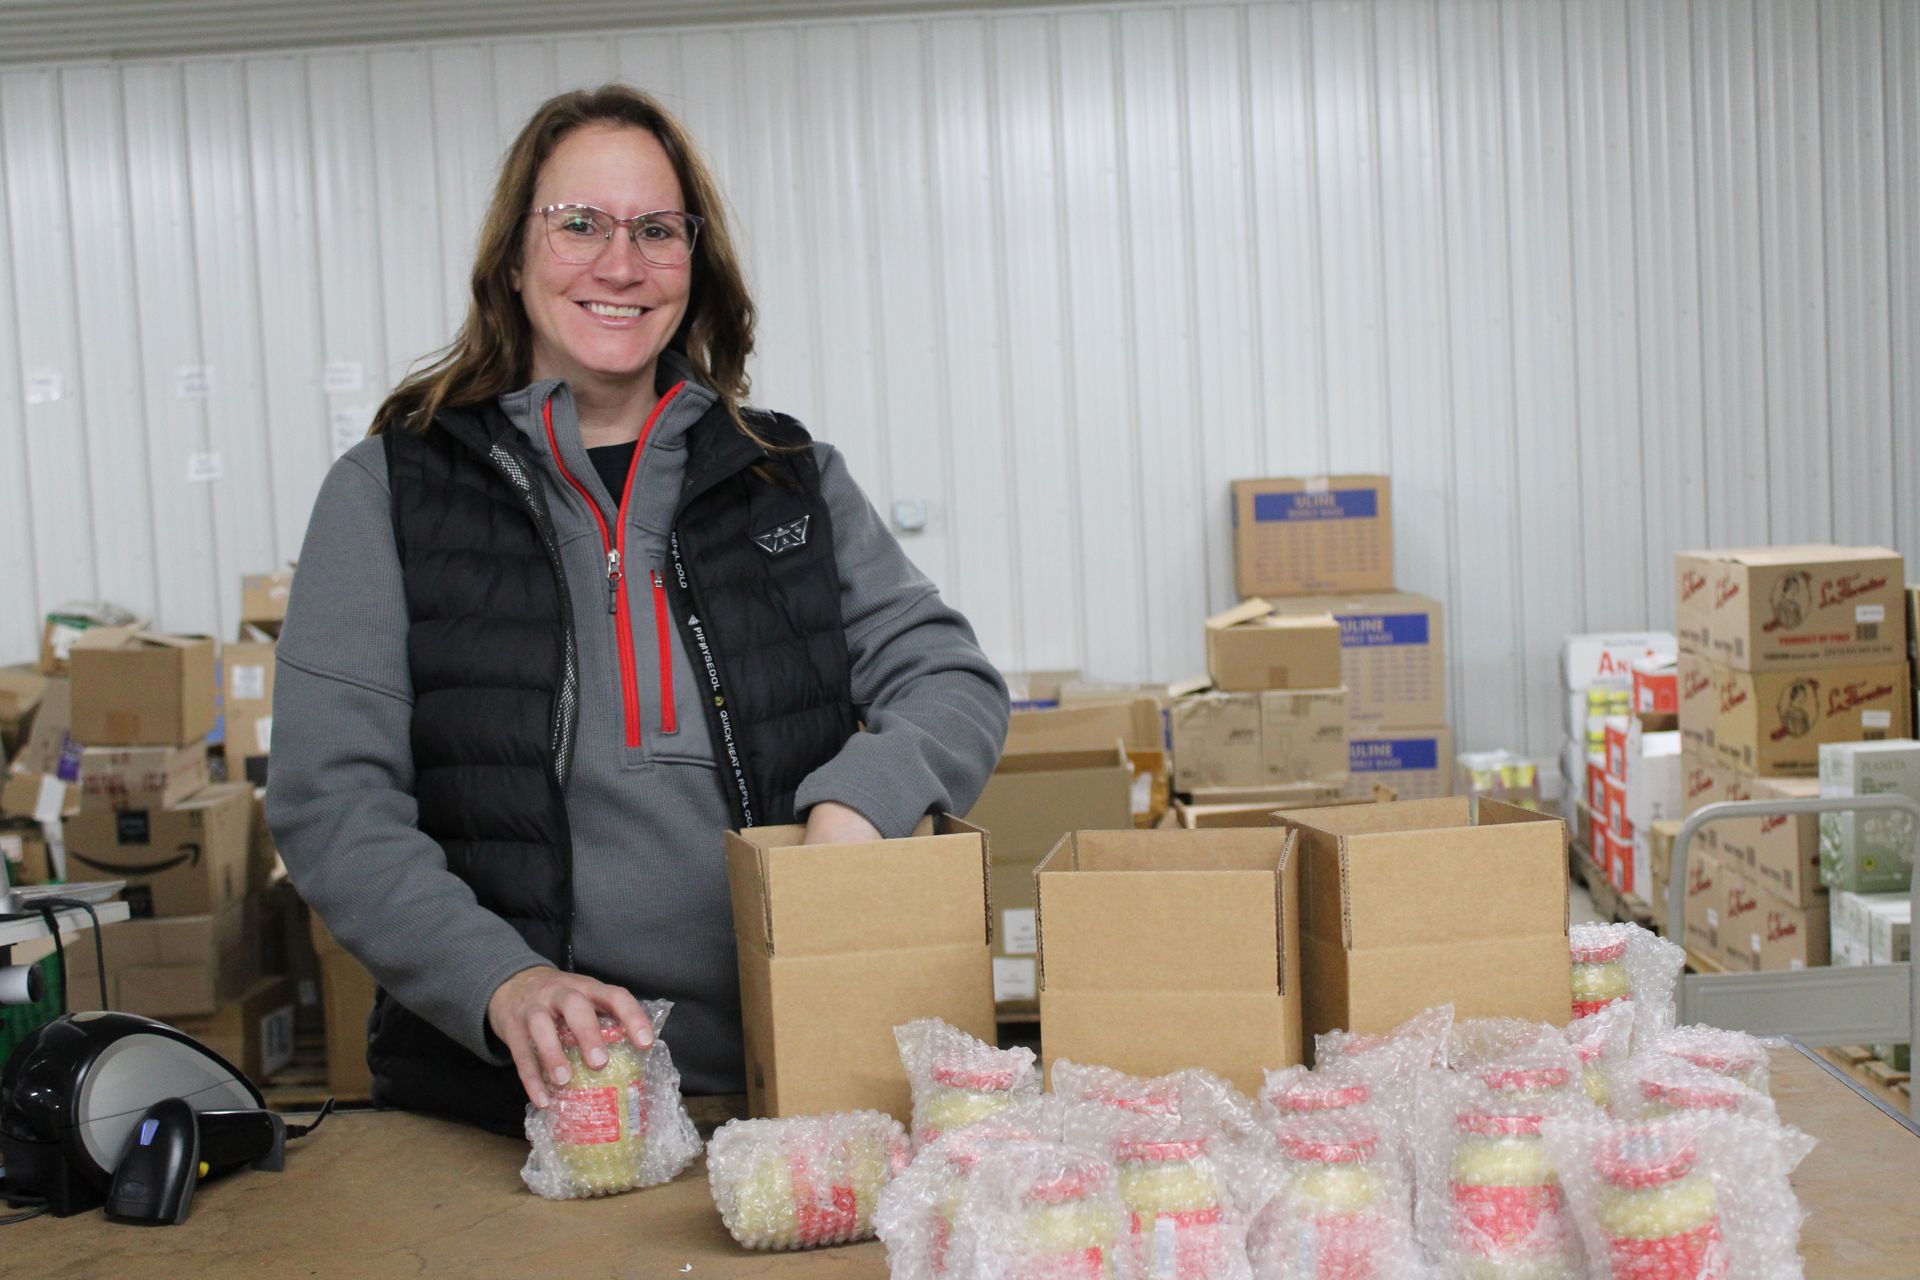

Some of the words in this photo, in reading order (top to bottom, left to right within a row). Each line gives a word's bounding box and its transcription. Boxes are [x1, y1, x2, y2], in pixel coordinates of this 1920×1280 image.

[1296, 493, 1336, 508] ULINE
[675, 562, 688, 589] COLD
[1341, 618, 1384, 633] ULINE
[720, 710, 732, 742] QUICK
[727, 742, 740, 768] HEAT
[1350, 743, 1393, 758] ULINE
